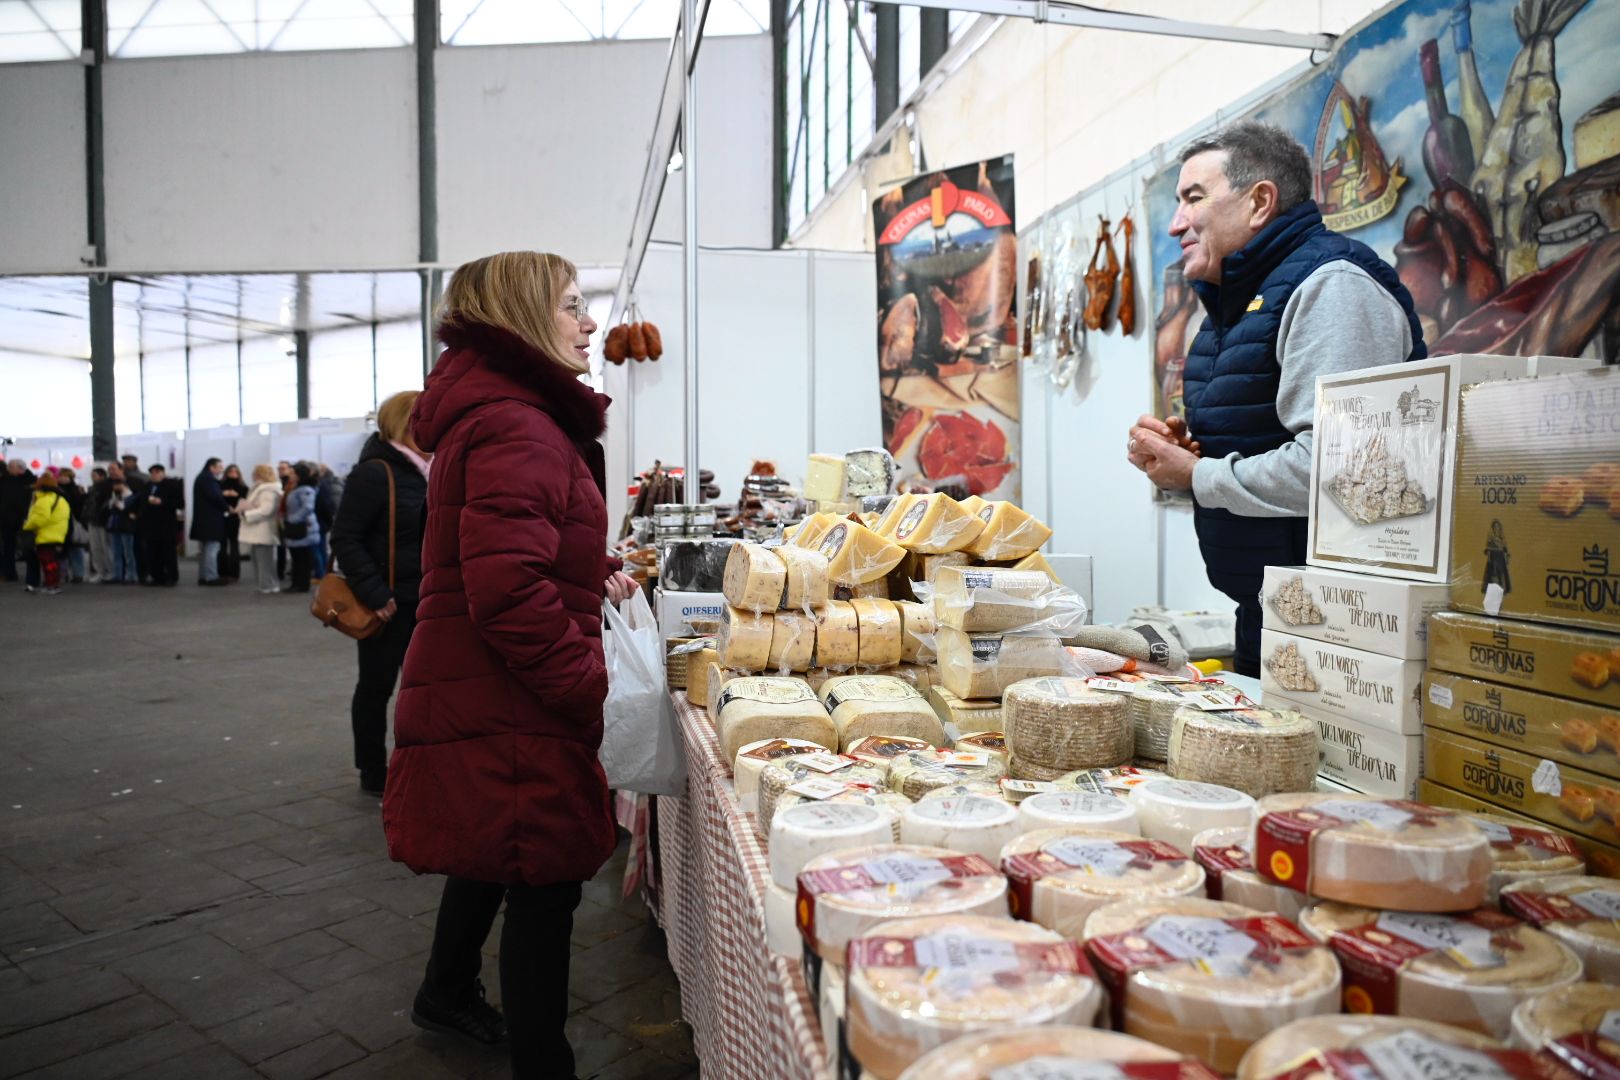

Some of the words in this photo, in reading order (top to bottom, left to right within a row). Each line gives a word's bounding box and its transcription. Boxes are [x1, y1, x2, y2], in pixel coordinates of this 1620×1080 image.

[888, 202, 931, 240] CECINAS
[963, 196, 994, 220] PABLO
[1473, 474, 1527, 486] ARTESANO
[1482, 487, 1517, 505] 100%
[1320, 585, 1364, 610] NICANORES
[1546, 574, 1620, 612] CORON
[1316, 650, 1360, 679] NICANORES
[1470, 646, 1535, 673] CORONAS
[1464, 705, 1526, 735] CORONAS
[1317, 720, 1362, 755] NICANORES
[1463, 764, 1524, 799] CORONAS
